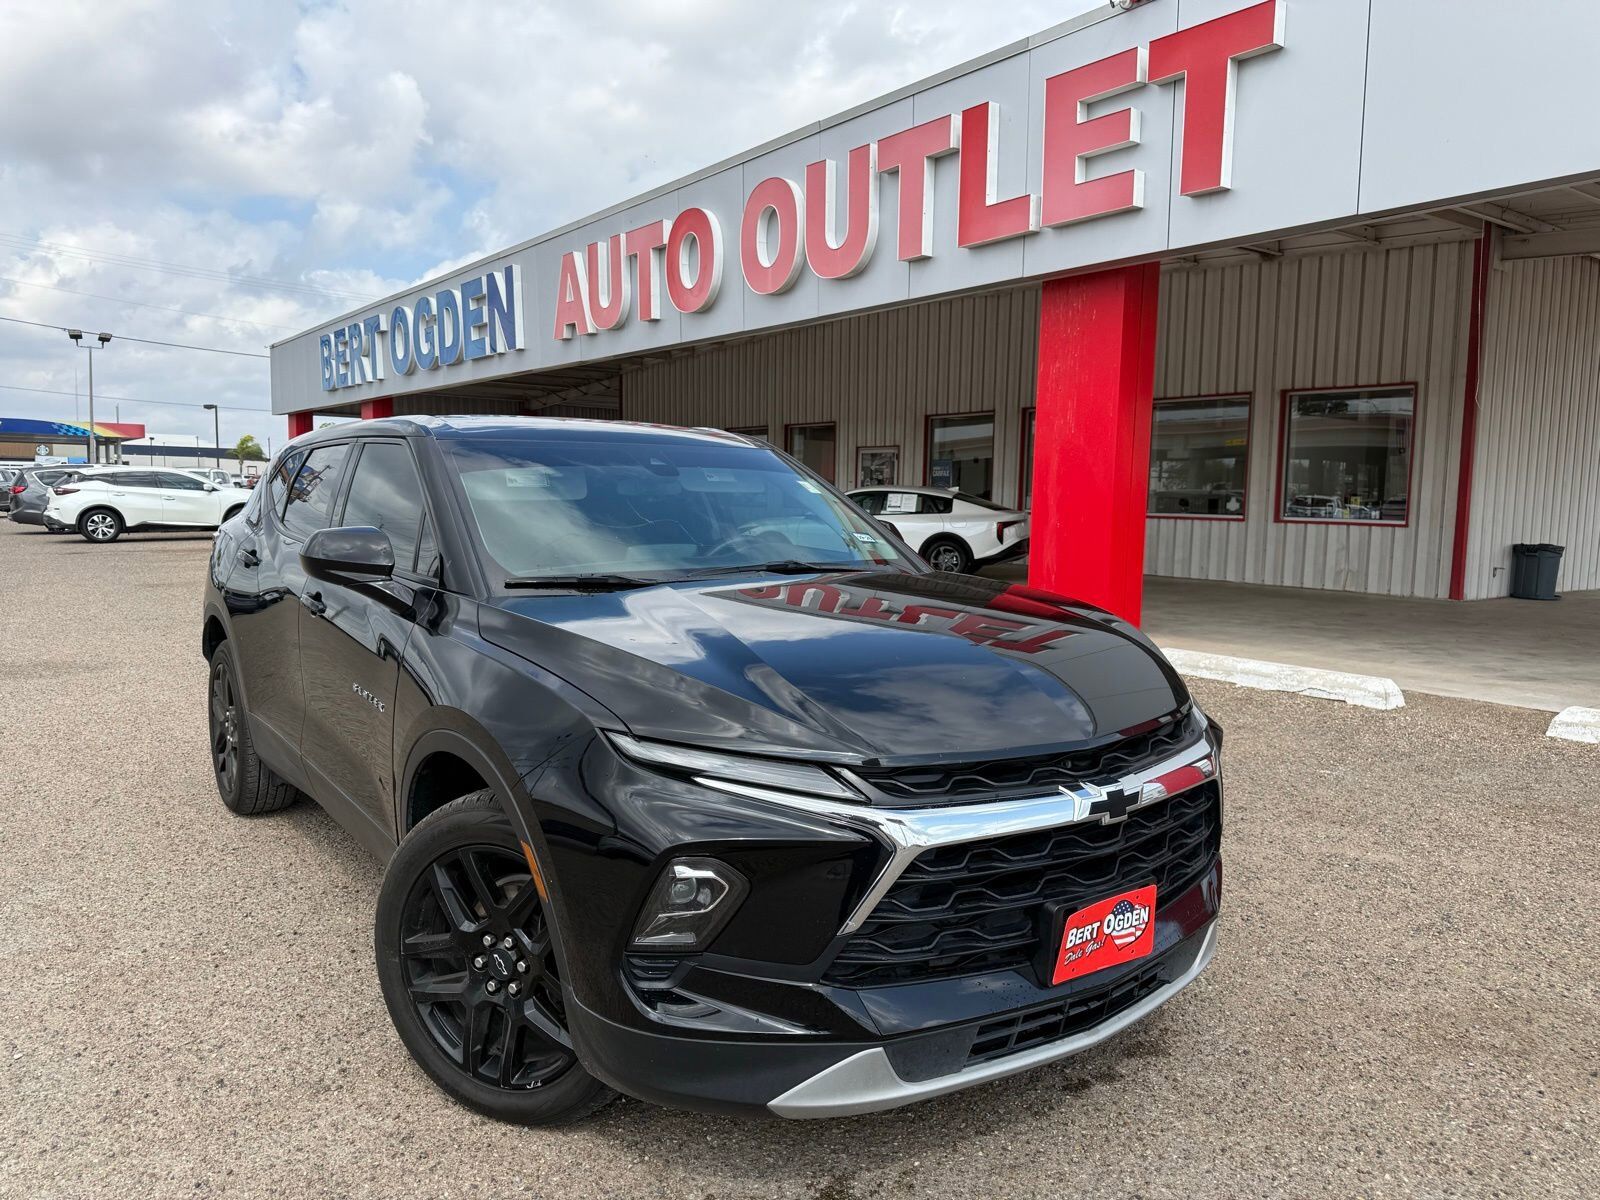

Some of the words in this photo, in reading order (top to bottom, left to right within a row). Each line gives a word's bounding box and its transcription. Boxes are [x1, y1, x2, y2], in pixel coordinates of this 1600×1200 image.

[320, 313, 388, 391] BERT
[390, 264, 525, 377] OGDEN
[553, 207, 724, 341] AUTO
[740, 0, 1286, 295] OUTLET
[1065, 921, 1100, 949] BERT
[1103, 906, 1149, 934] OGDEN
